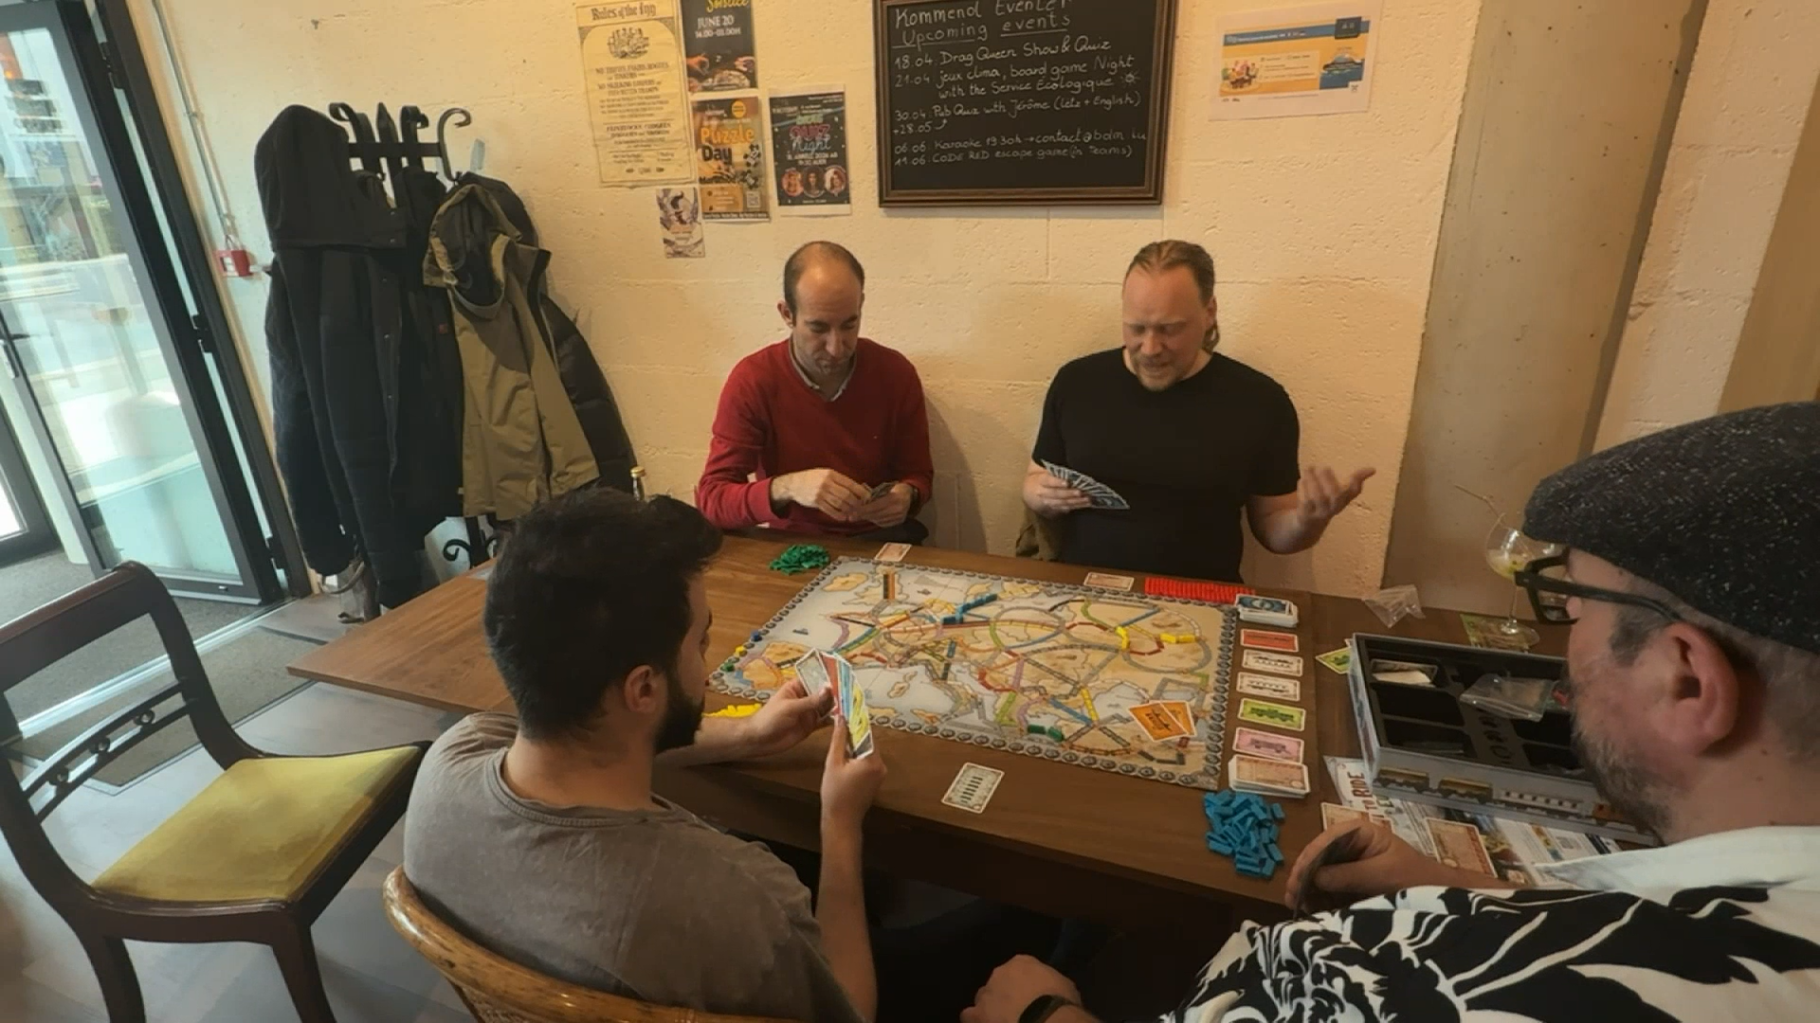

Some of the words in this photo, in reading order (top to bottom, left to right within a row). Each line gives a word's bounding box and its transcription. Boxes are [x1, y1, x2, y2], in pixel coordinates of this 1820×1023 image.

[698, 16, 721, 29] JUNE
[722, 15, 734, 26] 20
[896, 2, 982, 29] Kommend
[902, 23, 988, 51] Upcoming
[1002, 12, 1070, 31] events
[940, 51, 974, 66] Drag
[977, 47, 1016, 60] Queen
[1023, 42, 1059, 57] Show
[1074, 35, 1111, 52] Quiz
[936, 70, 963, 88] jeux
[1010, 61, 1047, 77] board
[1050, 62, 1087, 81] game
[1094, 54, 1135, 75] Night
[939, 84, 966, 99] with
[970, 82, 987, 96] the
[991, 81, 1032, 94] Service
[932, 104, 951, 117] Pub
[983, 100, 1007, 114] with
[701, 124, 754, 144] Puzzle
[702, 144, 732, 165] Day
[934, 139, 982, 150] Karaoke
[995, 149, 1033, 160] escape
[1347, 771, 1373, 798] RIDE
